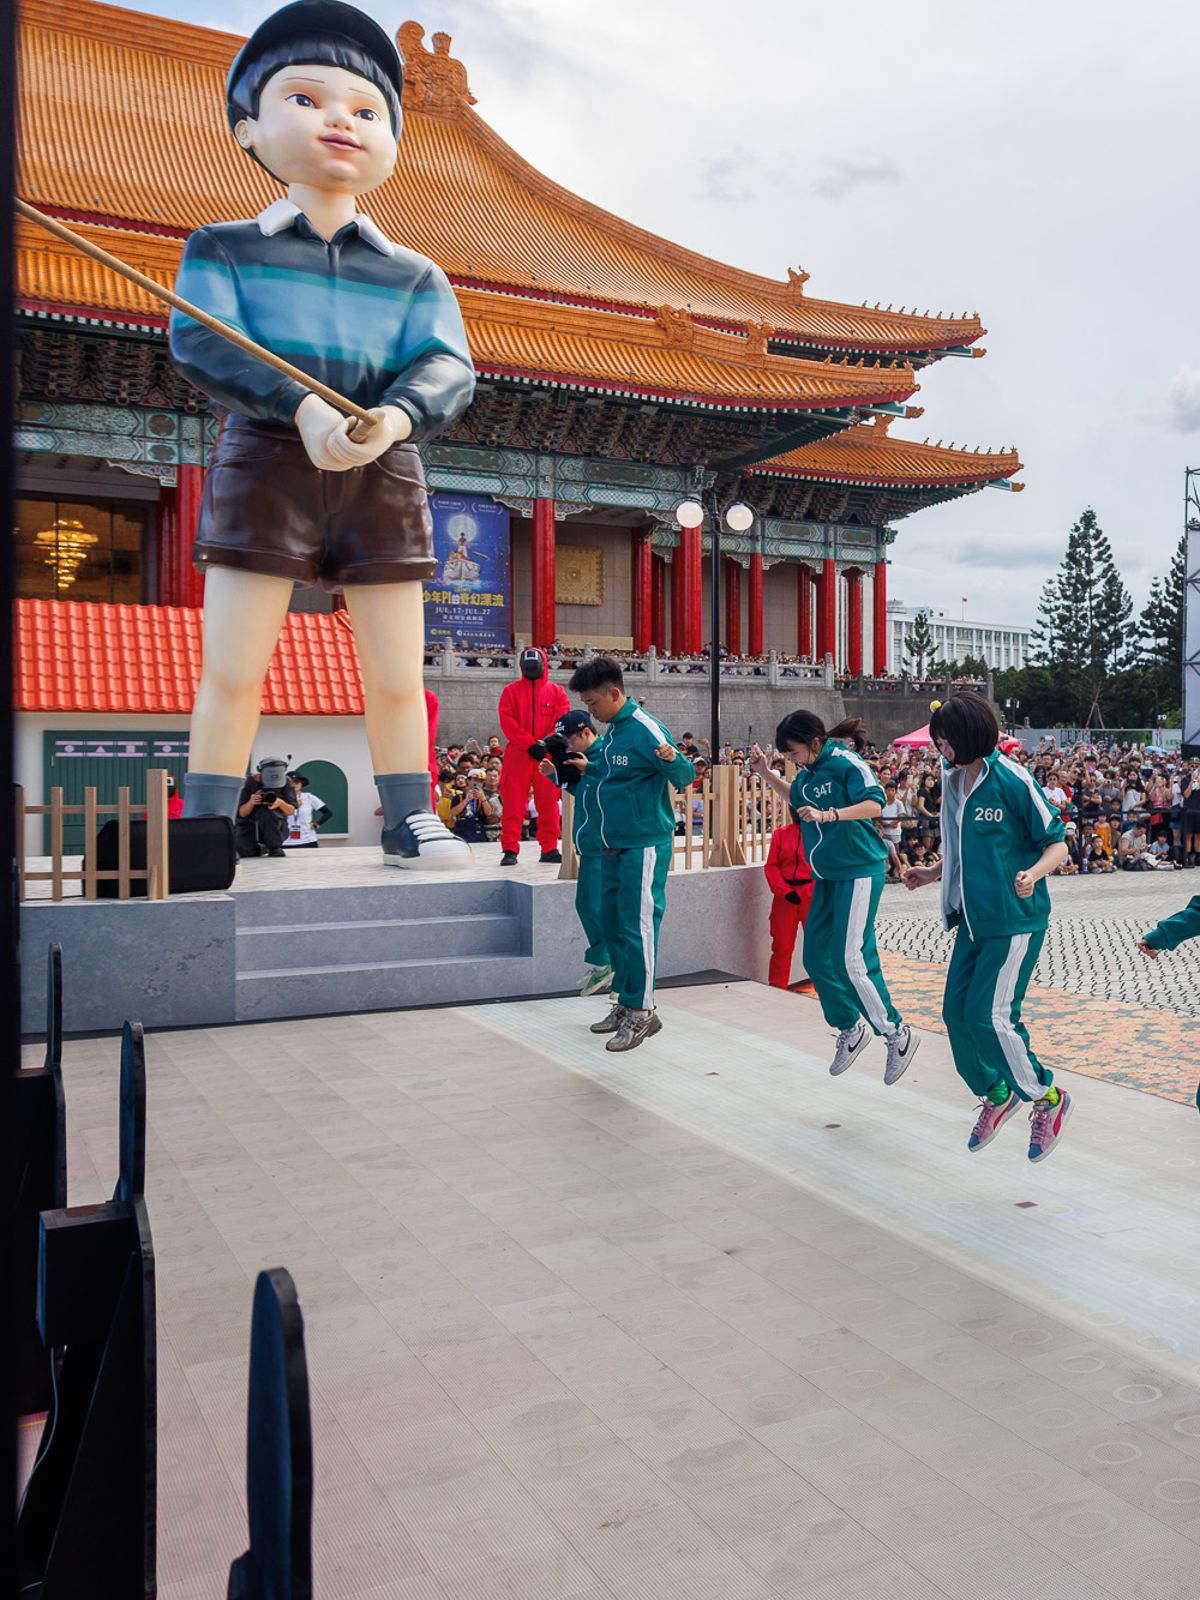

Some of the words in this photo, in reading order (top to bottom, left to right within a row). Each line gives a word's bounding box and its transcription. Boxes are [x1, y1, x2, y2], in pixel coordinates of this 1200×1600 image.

[611, 755, 628, 766] 188
[813, 782, 832, 798] 347
[975, 807, 1003, 822] 260
